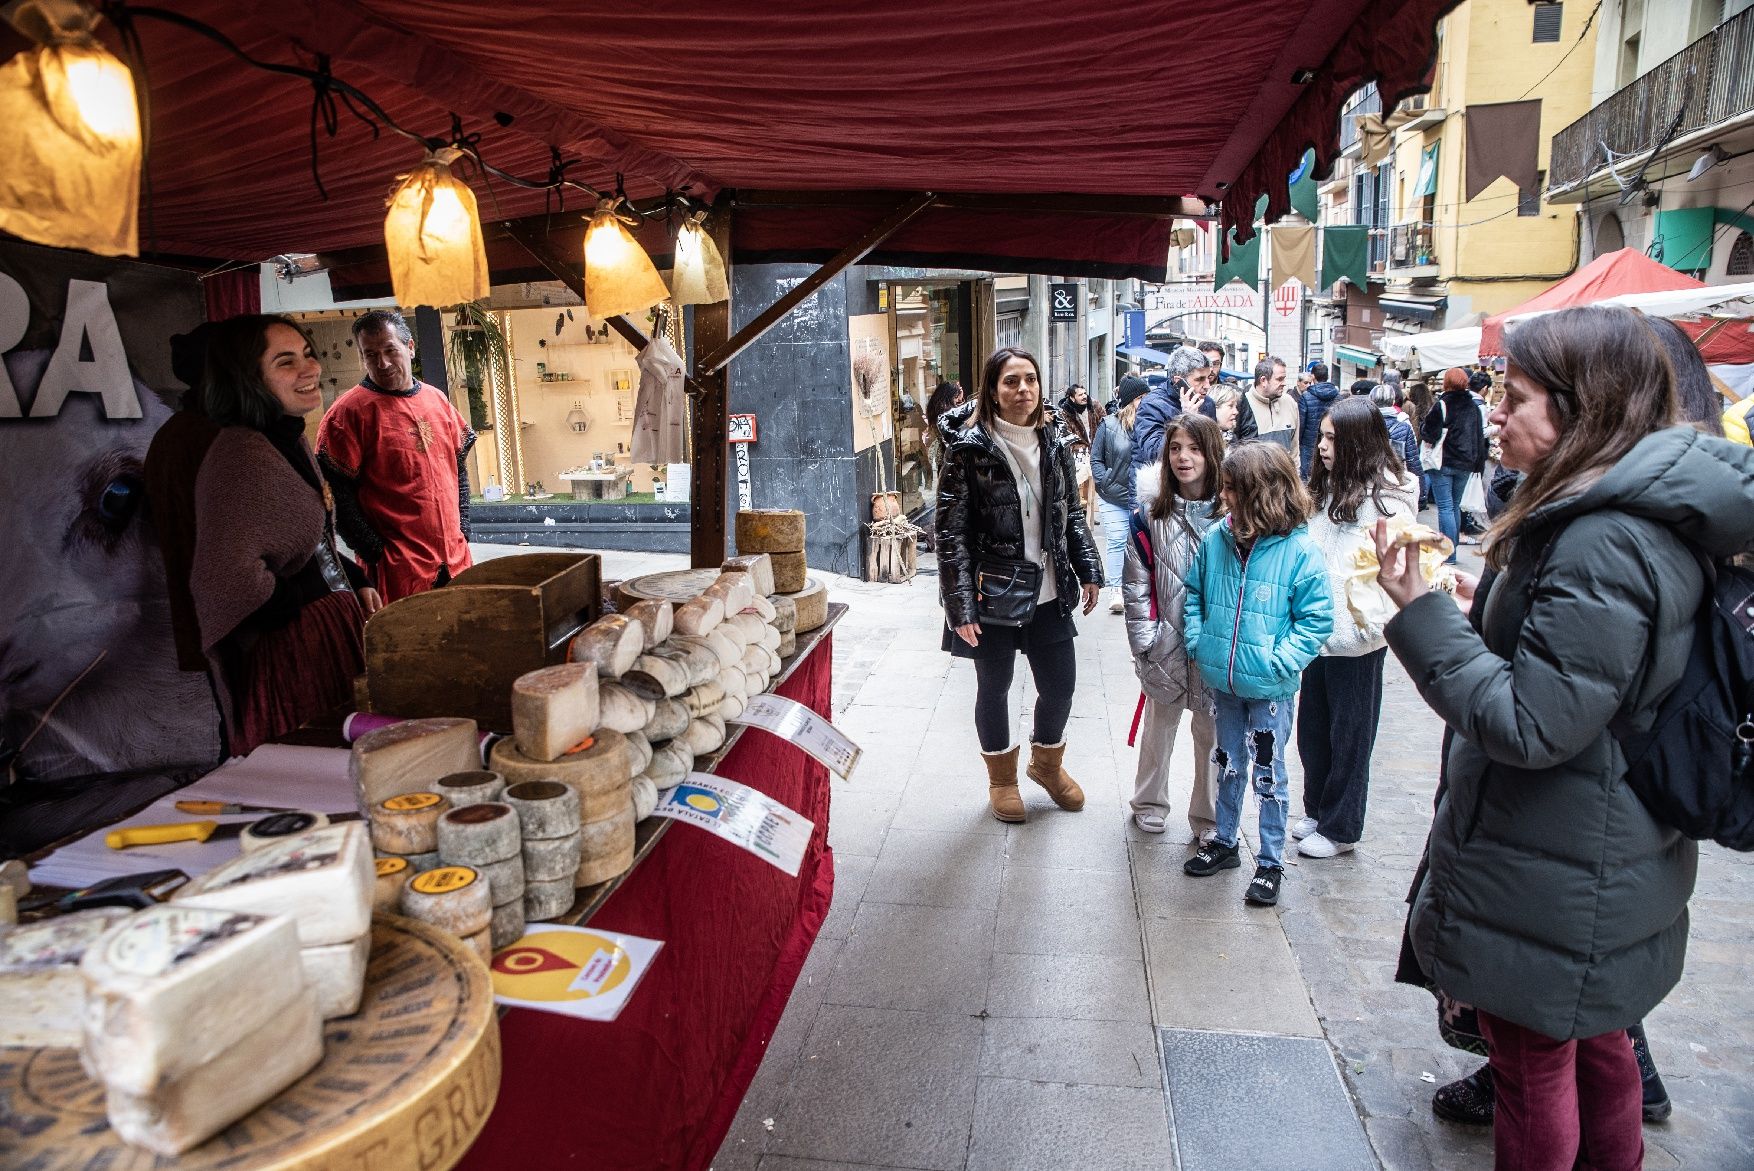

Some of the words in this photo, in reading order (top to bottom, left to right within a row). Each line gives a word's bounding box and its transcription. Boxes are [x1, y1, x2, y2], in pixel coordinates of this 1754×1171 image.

[1054, 289, 1074, 308] &
[1155, 296, 1175, 309] Fira
[1177, 299, 1186, 309] de
